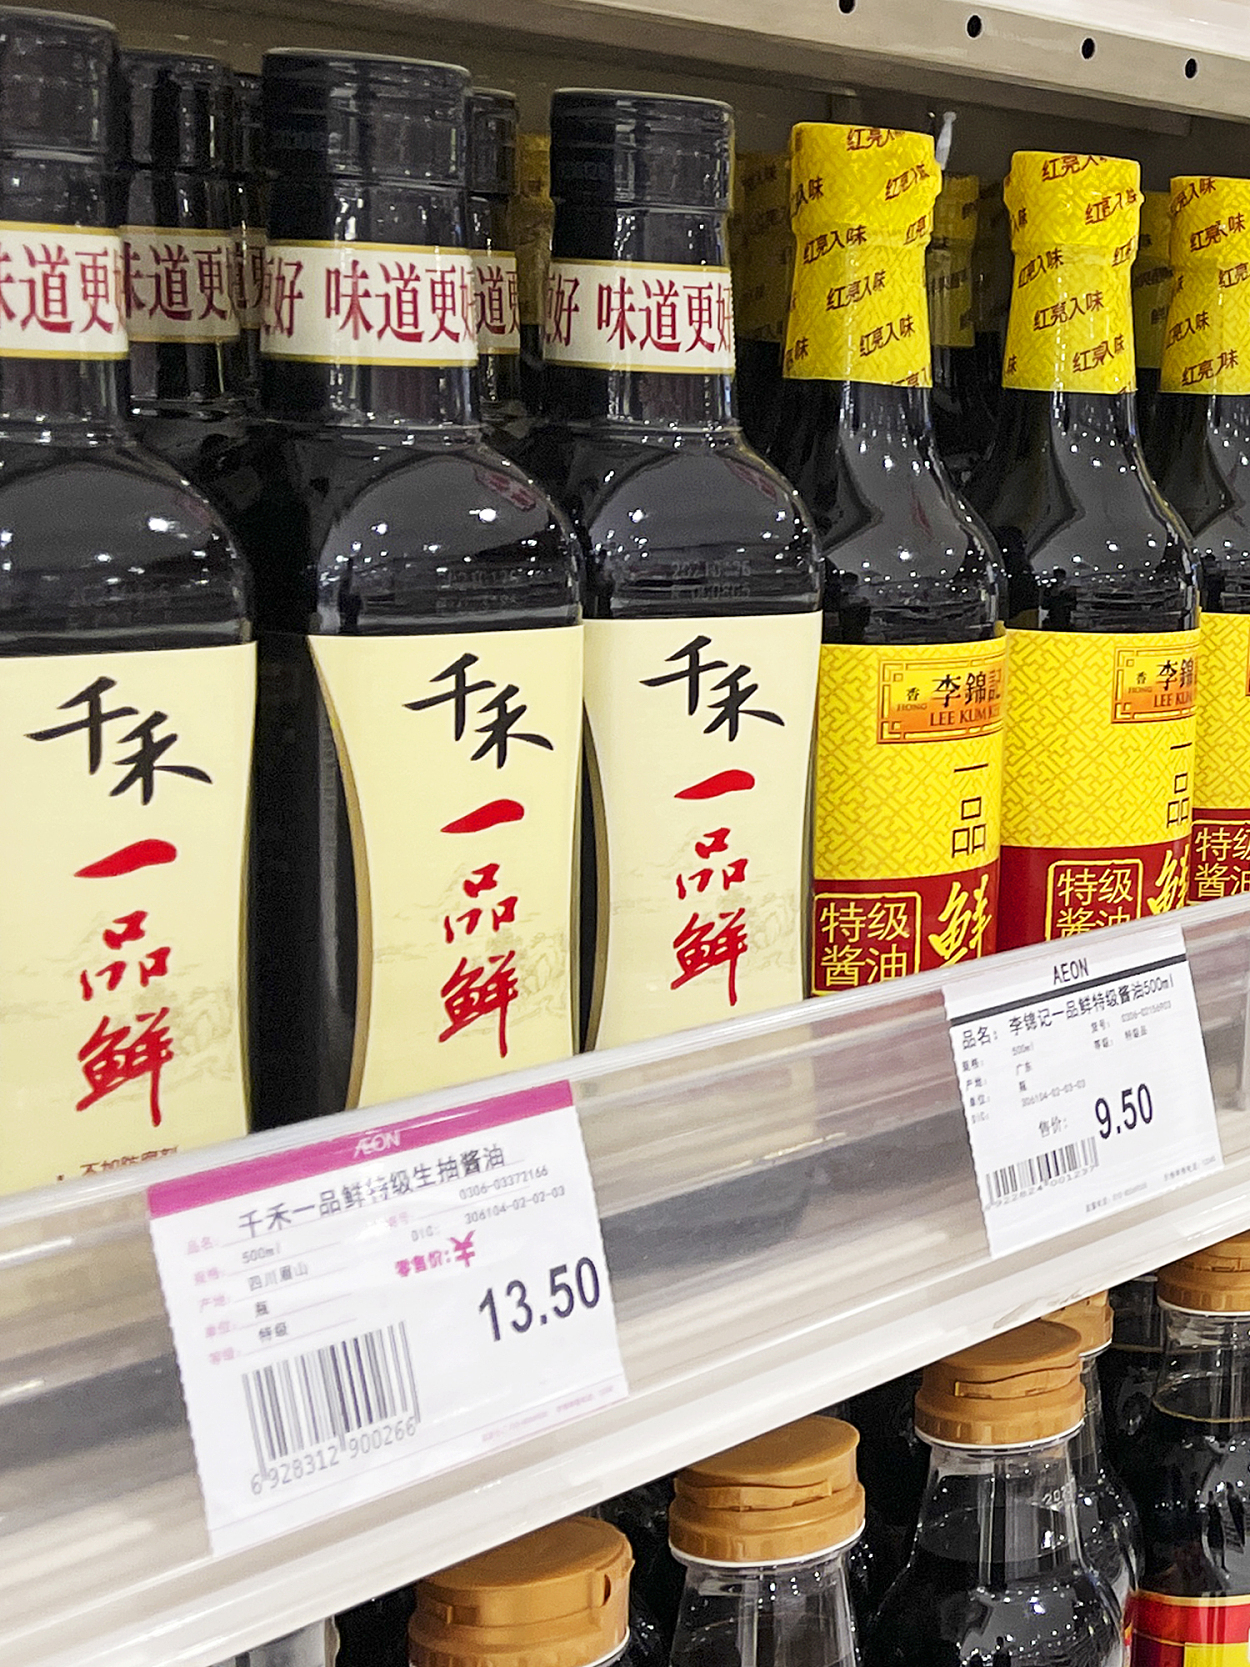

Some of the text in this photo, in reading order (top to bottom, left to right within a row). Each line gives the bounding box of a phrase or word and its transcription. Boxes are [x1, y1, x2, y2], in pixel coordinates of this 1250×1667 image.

[846, 127, 905, 152] 红亮入
[0, 243, 126, 334] 道更
[1033, 290, 1104, 331] 红亮入味
[402, 653, 554, 769] 千禾
[639, 635, 786, 741] 千禾
[929, 710, 956, 727] LEE
[959, 705, 987, 724] KUM
[1153, 692, 1172, 708] LEE
[1156, 656, 1197, 692] 李錦
[25, 676, 213, 806] 千禾
[1165, 741, 1193, 827] 一品
[951, 762, 989, 858] 一品
[439, 798, 525, 1058] 一品鲜
[671, 768, 756, 1007] 一品鲜
[819, 899, 911, 944] 特级
[1056, 868, 1135, 906] 特级
[74, 838, 178, 1127] 一品鲜
[820, 944, 909, 986] 酱油
[1053, 957, 1090, 986] AEON
[1095, 1083, 1154, 1140] 9.50
[238, 1142, 505, 1239] 千禾一品鲜特级生抽酱油
[478, 1256, 601, 1343] 13.50
